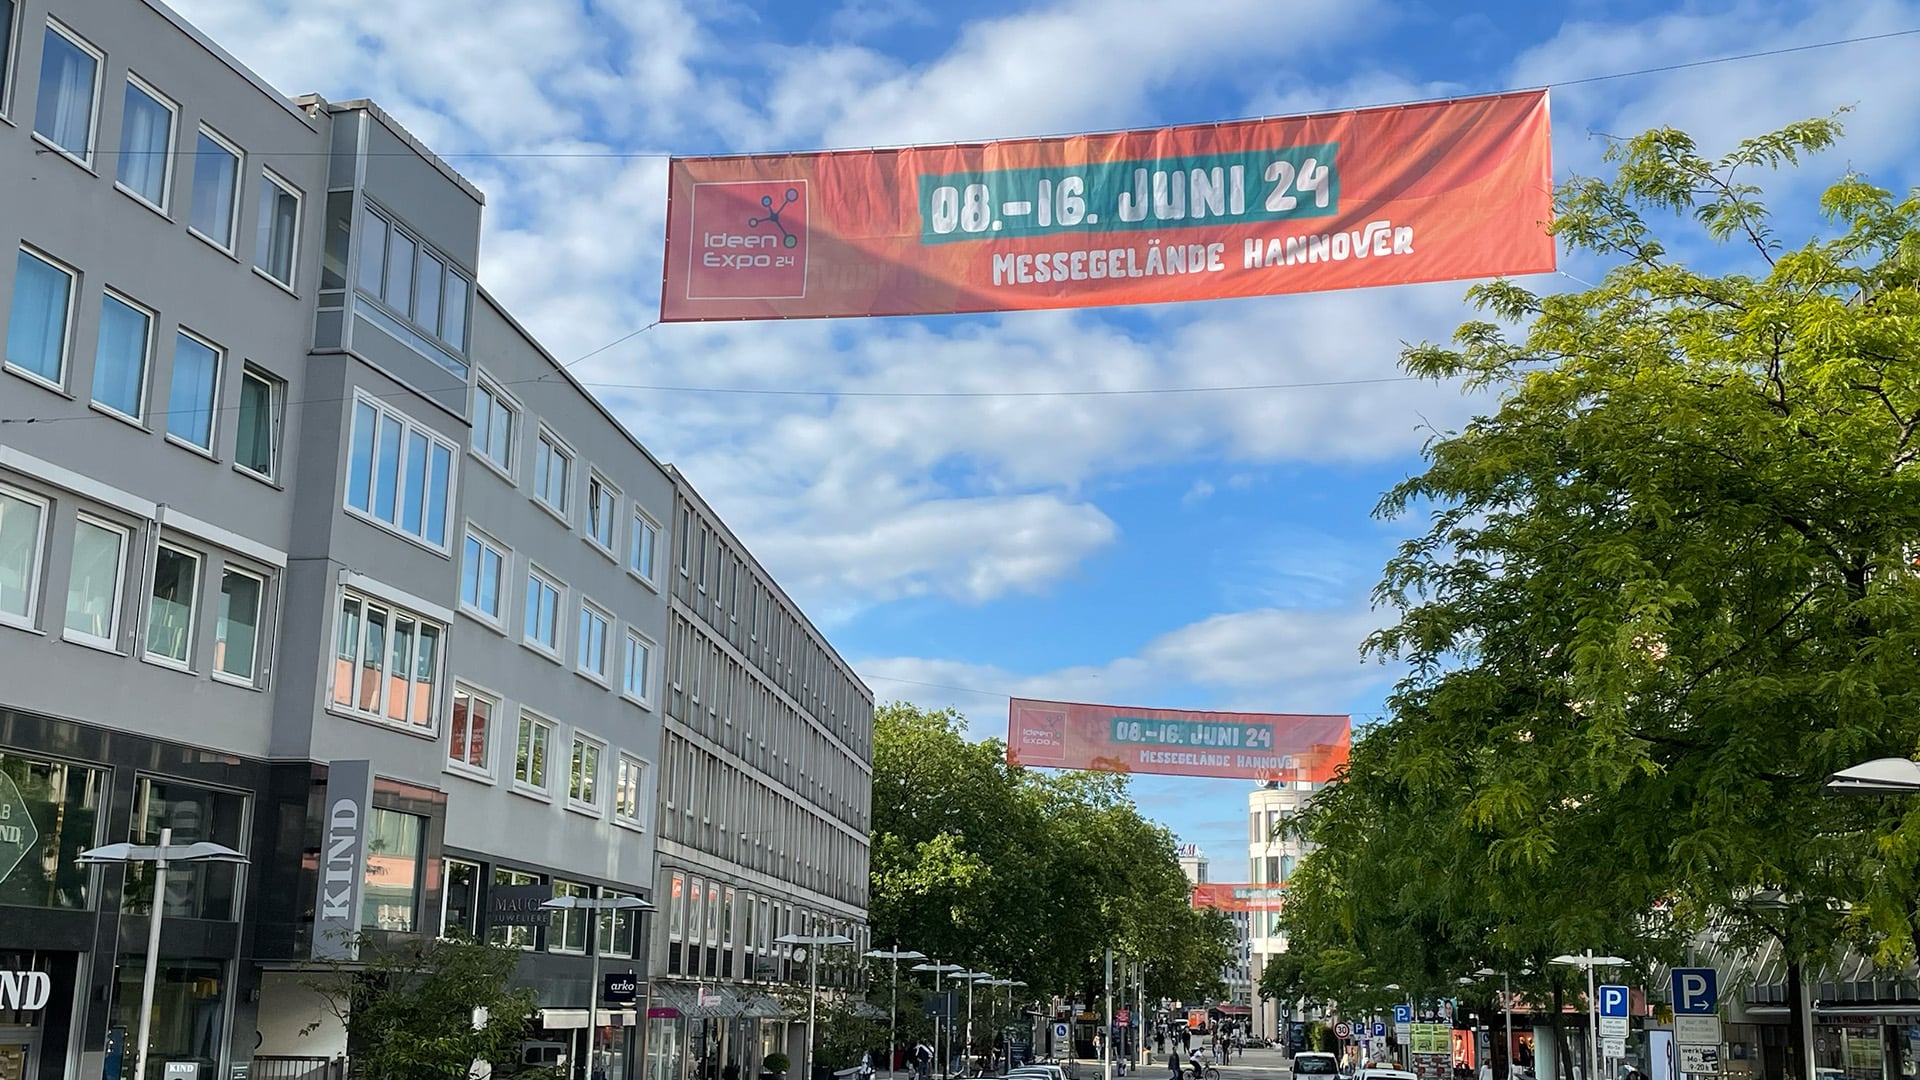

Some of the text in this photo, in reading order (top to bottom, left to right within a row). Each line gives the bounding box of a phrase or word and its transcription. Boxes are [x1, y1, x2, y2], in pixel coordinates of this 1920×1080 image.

[931, 158, 1329, 234] 08.-16. JUNI 24
[704, 232, 777, 248] Ideen
[703, 252, 794, 270] Expo 24
[992, 220, 1414, 286] MESSEGELÄNDE HANNOVER
[1116, 721, 1184, 744] 08.-16.
[1190, 724, 1239, 746] JUNI
[1245, 728, 1271, 747] 24
[1140, 751, 1230, 767] MESSEGELÄNDE
[322, 798, 358, 920] KIND
[610, 980, 635, 991] arko
[1682, 974, 1707, 1009] P
[1606, 990, 1622, 1014] P
[1397, 1008, 1406, 1020] P
[1337, 1025, 1347, 1035] 30
[1375, 1024, 1383, 1035] P
[168, 1064, 194, 1073] KIND
